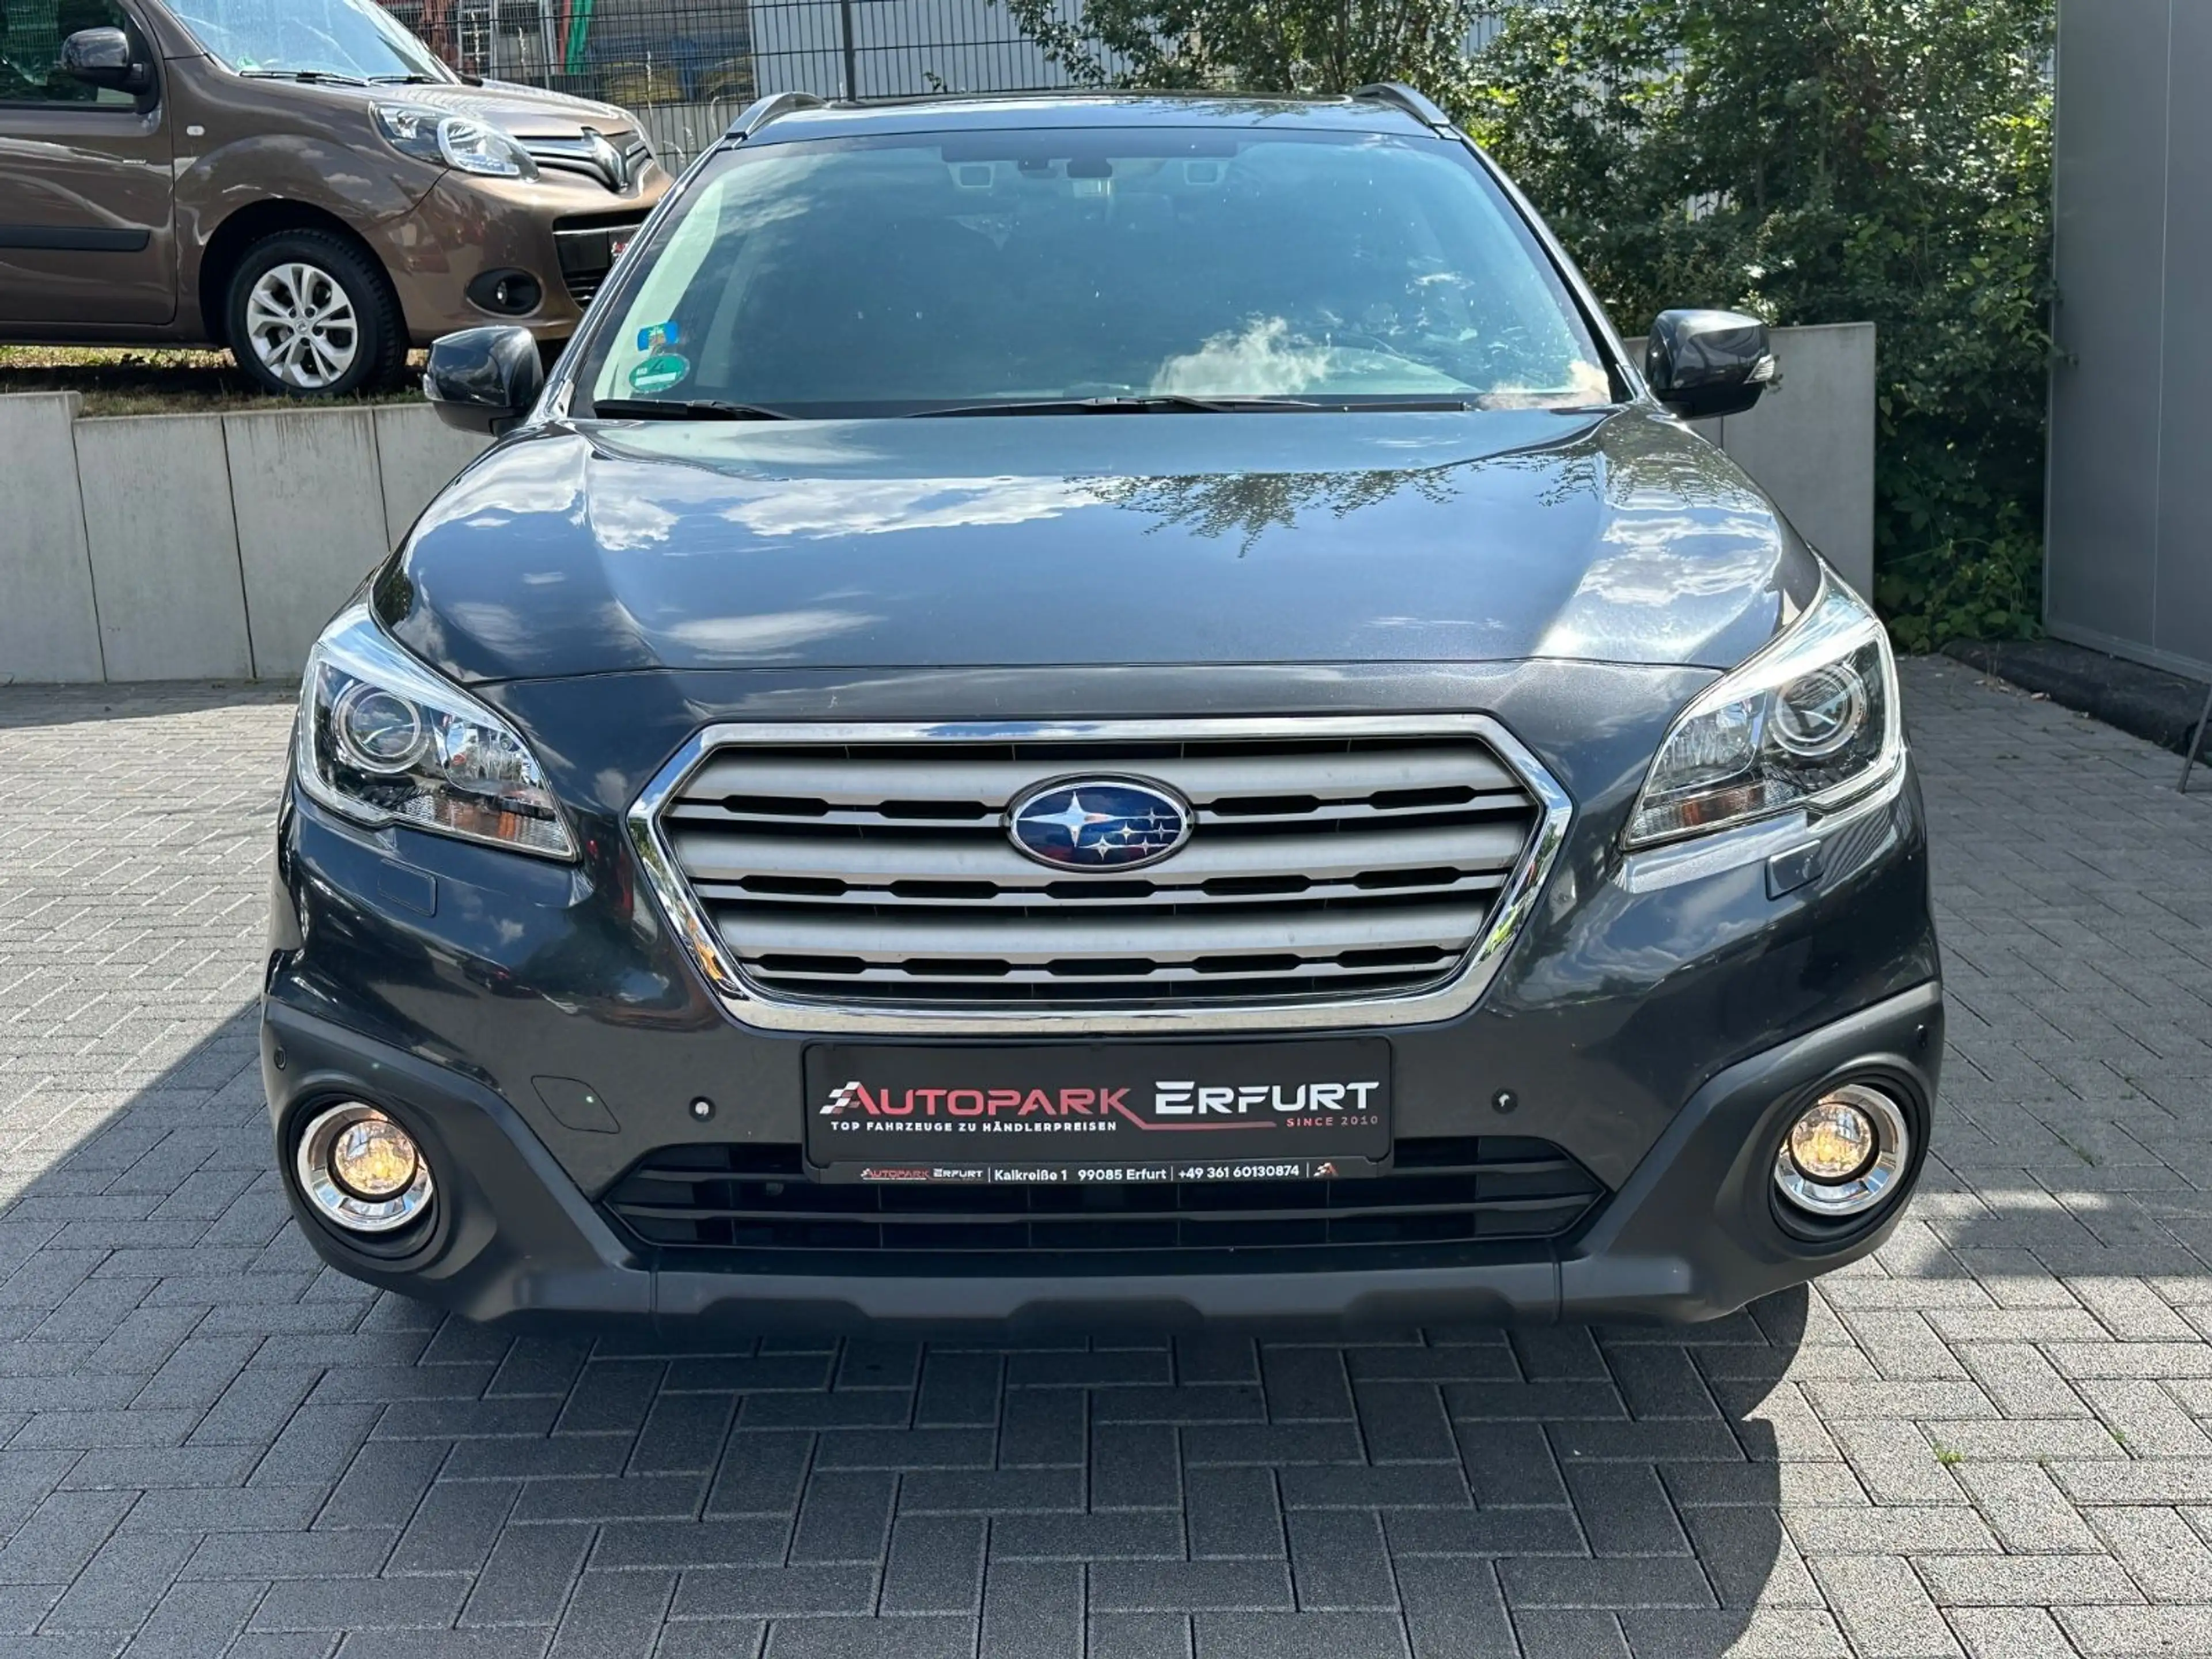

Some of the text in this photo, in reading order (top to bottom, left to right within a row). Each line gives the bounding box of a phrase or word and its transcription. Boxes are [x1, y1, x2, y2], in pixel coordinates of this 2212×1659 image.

[819, 1081, 1380, 1116] AUTOPARK ERFURT
[831, 1121, 1117, 1132] TOP FAHRZEUGE ZU HÄNDLERPREISEN
[1286, 1116, 1379, 1127] SINCE 2010
[933, 1168, 983, 1177] ERFURT
[1061, 1169, 1068, 1180] 1
[1078, 1169, 1122, 1181] 99085
[1126, 1168, 1166, 1180] Erfurt
[1178, 1165, 1300, 1179] +49 361 60130874
